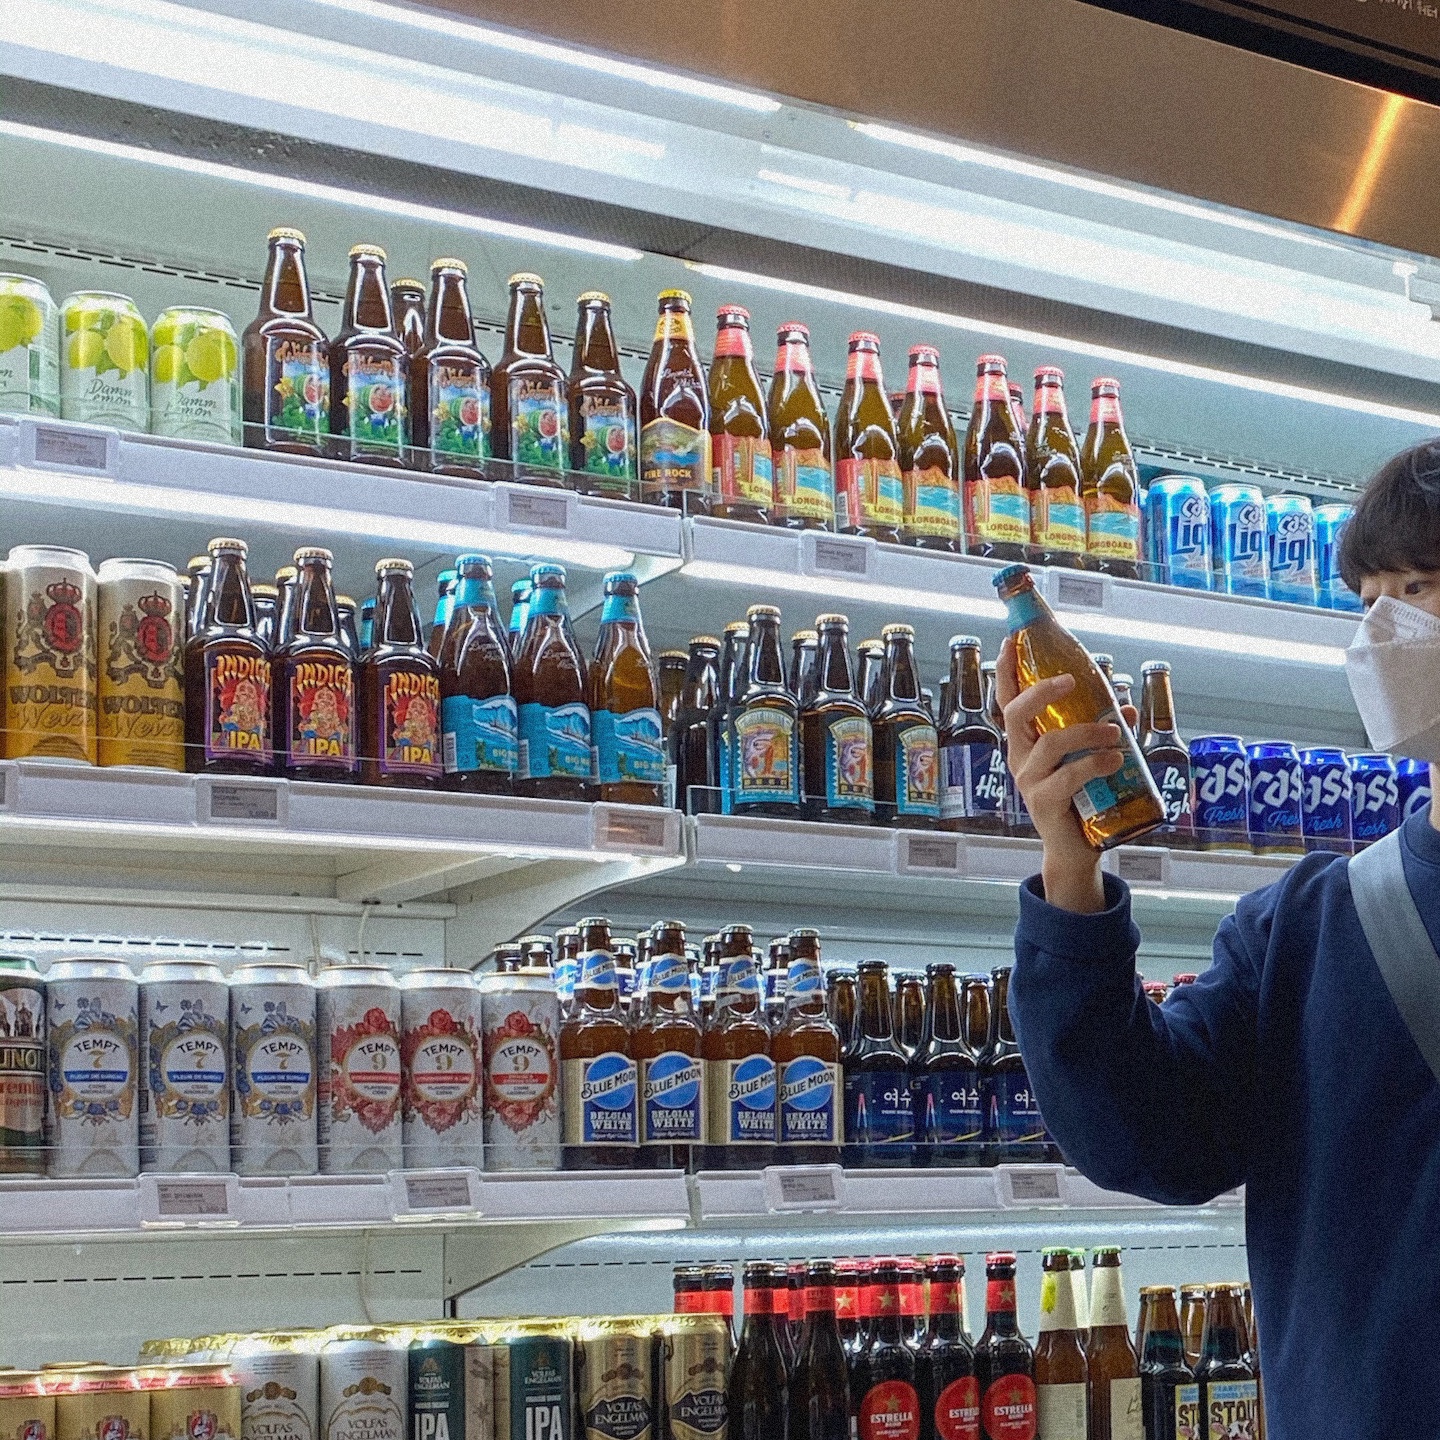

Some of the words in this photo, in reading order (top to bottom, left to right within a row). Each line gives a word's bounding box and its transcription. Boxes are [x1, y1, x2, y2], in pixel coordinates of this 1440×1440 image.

[229, 732, 261, 751] IPA
[309, 738, 341, 757] IPA
[403, 746, 431, 764] IPA
[1162, 766, 1188, 791] Be
[73, 1039, 122, 1054] TEMPT
[176, 1040, 220, 1055] TEMPT
[261, 1040, 304, 1055] TEMPT
[358, 1041, 397, 1057] TEMPT
[422, 1042, 464, 1058] TEMPT
[500, 1044, 541, 1059] TEMPT
[371, 1052, 387, 1072] 9
[436, 1052, 453, 1071] 9
[512, 1056, 531, 1072] 9
[580, 1081, 613, 1101] BLUE
[614, 1067, 637, 1087] MOON
[643, 1078, 674, 1100] BLUE
[675, 1065, 703, 1085] MOON
[779, 1081, 807, 1101] BLUE
[808, 1068, 835, 1088] MOON
[728, 1081, 759, 1100] BLUE
[884, 1088, 912, 1108] 여수
[951, 1088, 980, 1107] 여수
[590, 1110, 632, 1121] BELGIAN
[651, 1109, 695, 1120] BELGIAN
[786, 1111, 828, 1122] BELGIAN
[592, 1120, 633, 1131] WHITE
[653, 1119, 695, 1130] WHITE
[739, 1120, 775, 1131] WHITE
[788, 1120, 828, 1131] WHITE
[605, 1401, 643, 1414] VOLFAS
[993, 1403, 1034, 1416] ESTRELLA
[869, 1411, 914, 1424] ESTRELLA
[251, 1421, 293, 1435] VOLFAS
[347, 1419, 388, 1432] VOLFAS
